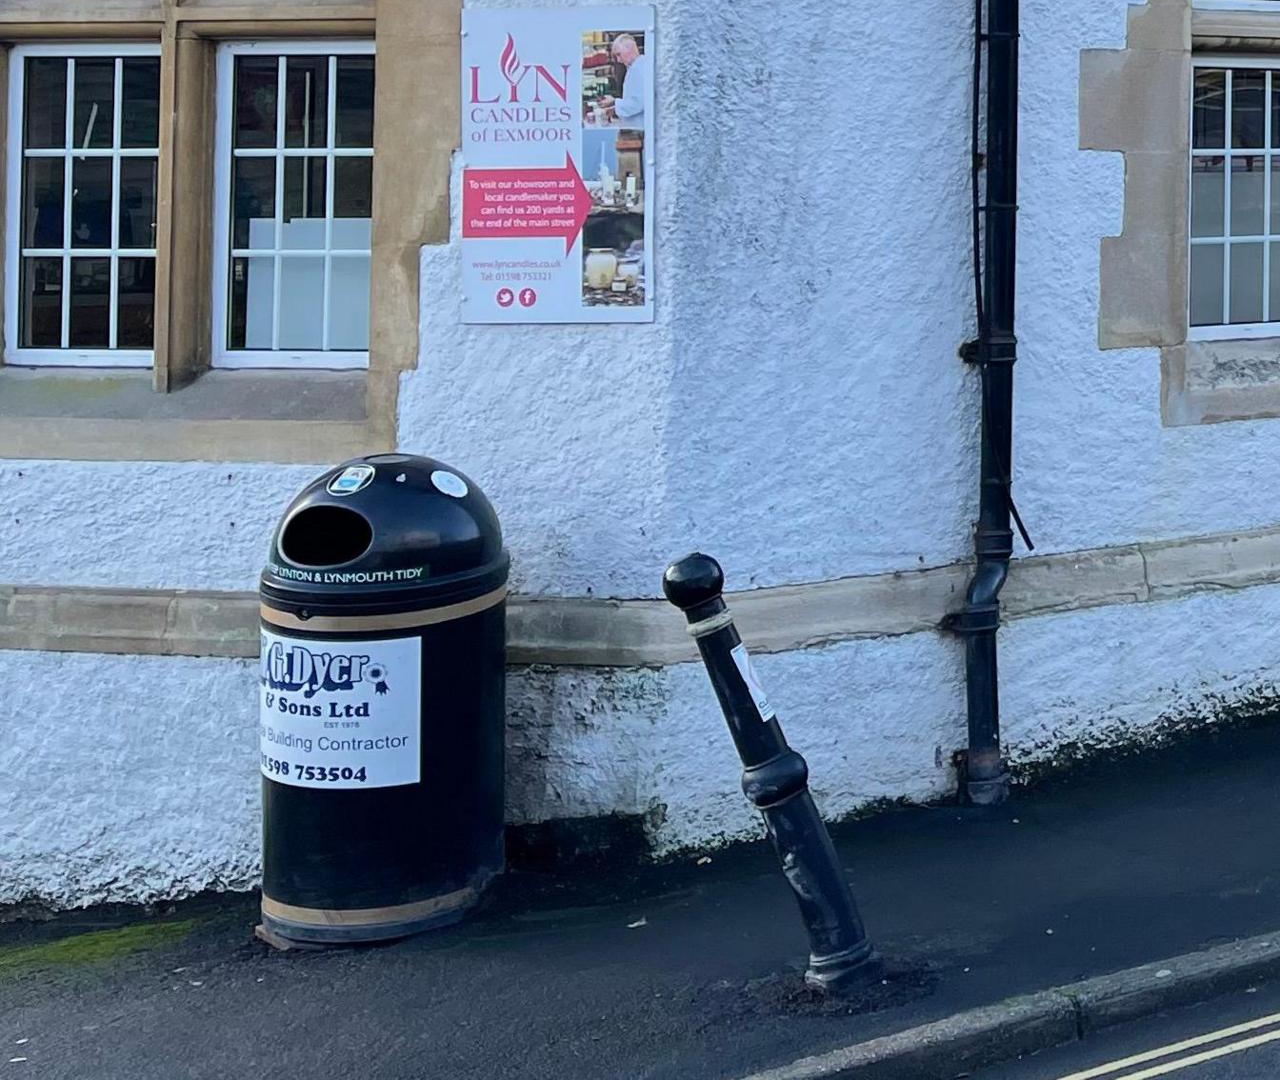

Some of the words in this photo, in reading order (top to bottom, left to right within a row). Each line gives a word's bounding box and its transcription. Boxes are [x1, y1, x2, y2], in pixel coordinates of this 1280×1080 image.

[469, 60, 572, 104] LYN
[470, 107, 572, 123] CANDLES
[471, 127, 488, 142] of
[494, 127, 572, 142] EXMOOR
[469, 180, 479, 189] To
[480, 180, 496, 189] visit
[498, 181, 512, 189] our
[514, 179, 557, 188] showroom
[559, 179, 575, 188] and
[484, 193, 504, 202] local
[505, 192, 558, 202] candlemaker
[559, 193, 575, 203] you
[481, 207, 496, 215] can
[497, 206, 513, 214] find
[526, 206, 541, 214] 200
[542, 206, 564, 215] yards
[566, 206, 575, 214] at
[470, 219, 484, 228] the
[486, 219, 502, 228] end
[503, 219, 512, 227] of
[513, 219, 527, 227] the
[528, 219, 550, 227] main
[551, 218, 575, 227] street
[279, 567, 312, 581] LYNTON
[314, 573, 321, 582] &
[324, 569, 393, 583] LYNMOUTH
[394, 567, 423, 581] TIDY
[265, 692, 275, 708] &
[278, 696, 322, 717] Sons
[329, 702, 370, 718] Ltd
[324, 721, 339, 729] EST
[267, 727, 313, 752] Building
[318, 734, 409, 751] Contractor
[261, 752, 290, 775] 1598
[295, 765, 367, 782] 753504
